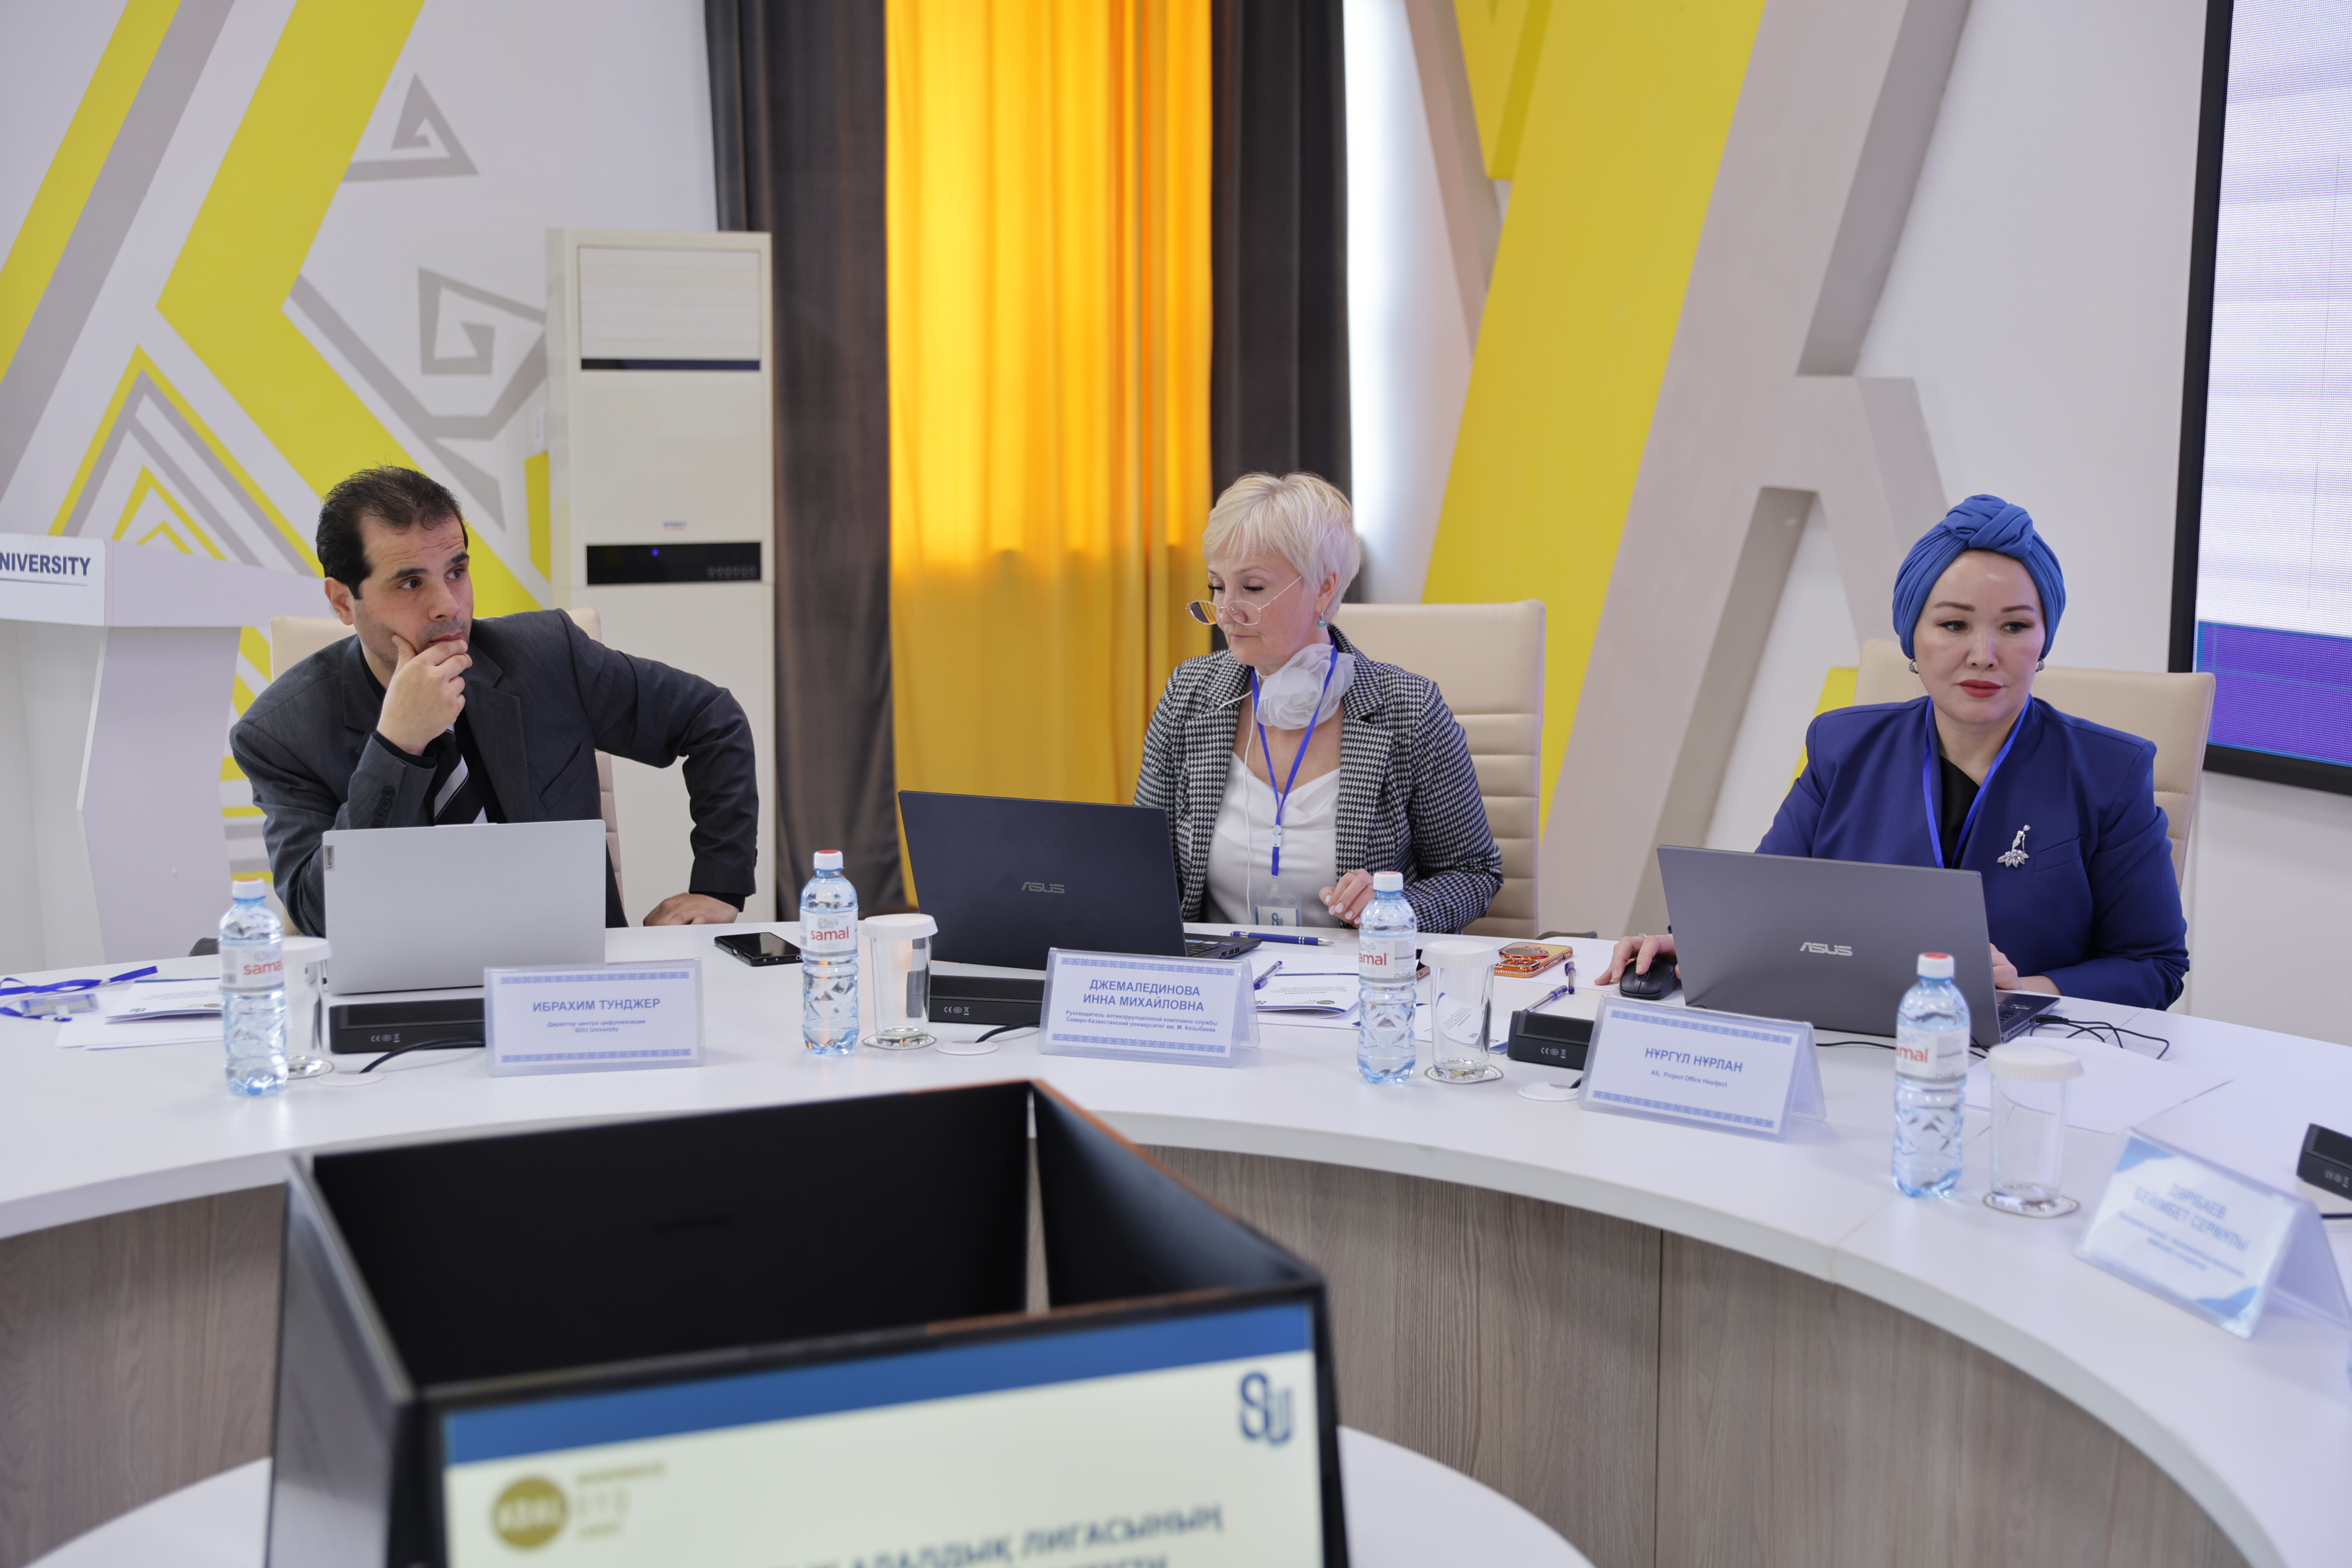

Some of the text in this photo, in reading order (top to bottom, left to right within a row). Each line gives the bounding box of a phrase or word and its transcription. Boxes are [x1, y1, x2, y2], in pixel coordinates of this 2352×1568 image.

[0, 552, 91, 576] NIVERSITY
[1021, 882, 1065, 894] ASUS
[811, 926, 849, 941] samal
[1799, 942, 1853, 956] ASUS
[1359, 953, 1387, 966] amal
[243, 960, 282, 975] sama
[1089, 980, 1200, 996] ДЖЕМАЛЕДИНОВА
[533, 998, 661, 1012] ИБРАХИМ ТУНДЖЕР
[1083, 994, 1204, 1011] ИННА МИХАЙЛОВНА
[1066, 1017, 1128, 1026] Северо-Казахстанский
[1896, 1046, 1928, 1063] mal
[1693, 1055, 1743, 1073] НҰРЛАН
[1702, 1079, 1728, 1087] Headject
